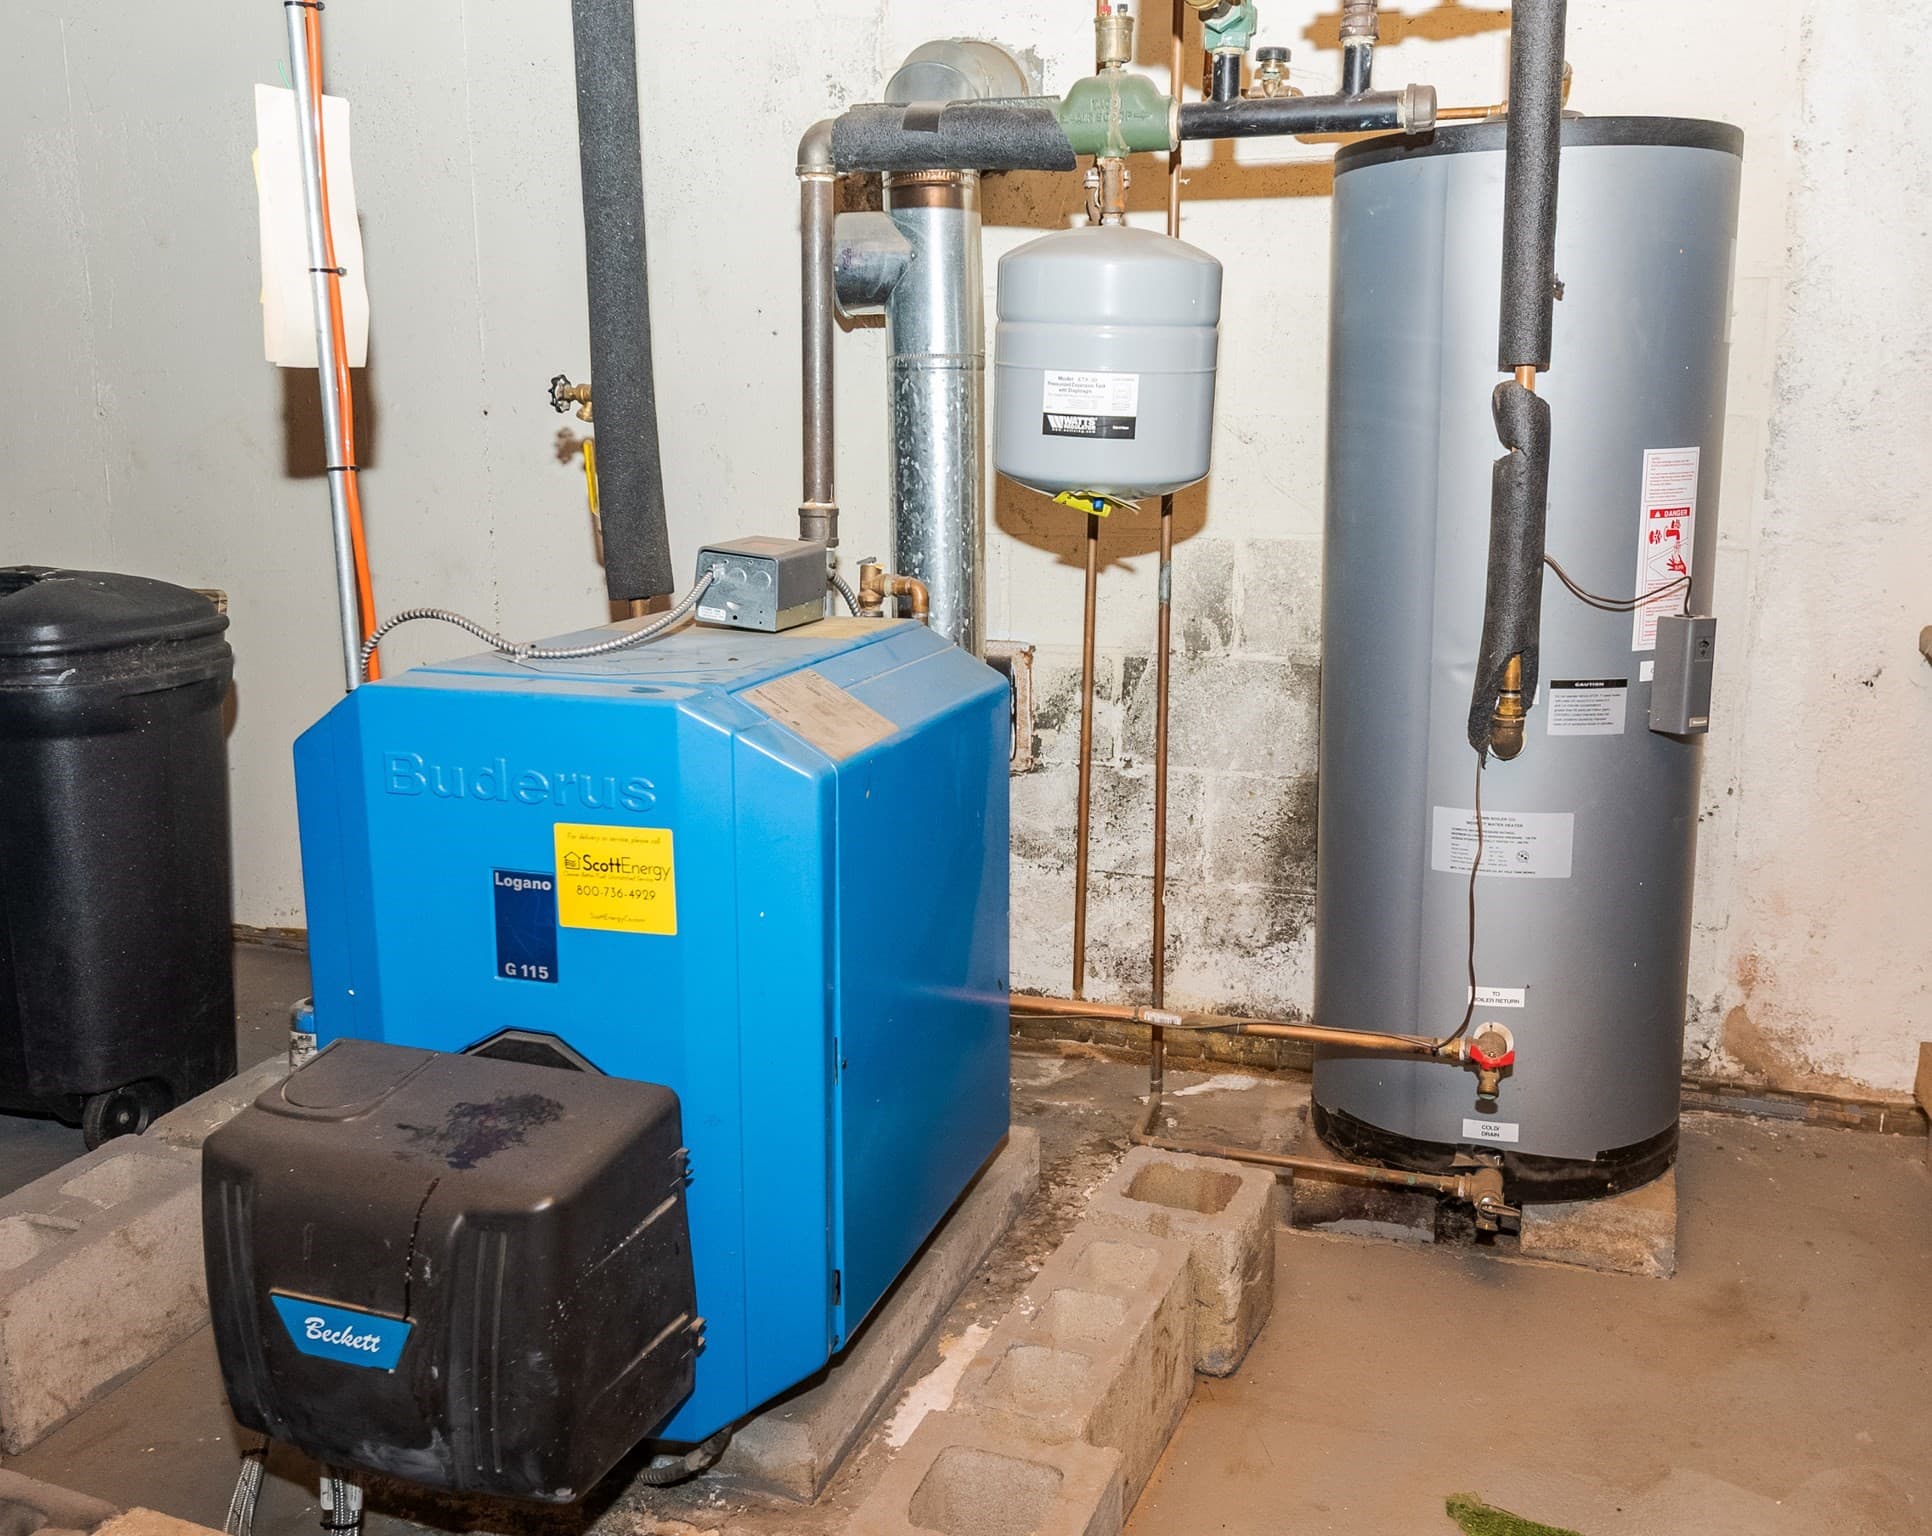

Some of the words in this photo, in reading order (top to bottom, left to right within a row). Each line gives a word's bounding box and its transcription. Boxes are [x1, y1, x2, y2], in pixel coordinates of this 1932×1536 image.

[1663, 509, 1688, 517] DANGER
[384, 751, 656, 812] Buderus
[582, 854, 671, 881] ScottEnergy
[494, 872, 552, 891] Logano
[576, 885, 656, 901] 800-736-4929
[505, 962, 517, 976] G
[521, 964, 549, 980] 115
[304, 1316, 382, 1353] Beckett
